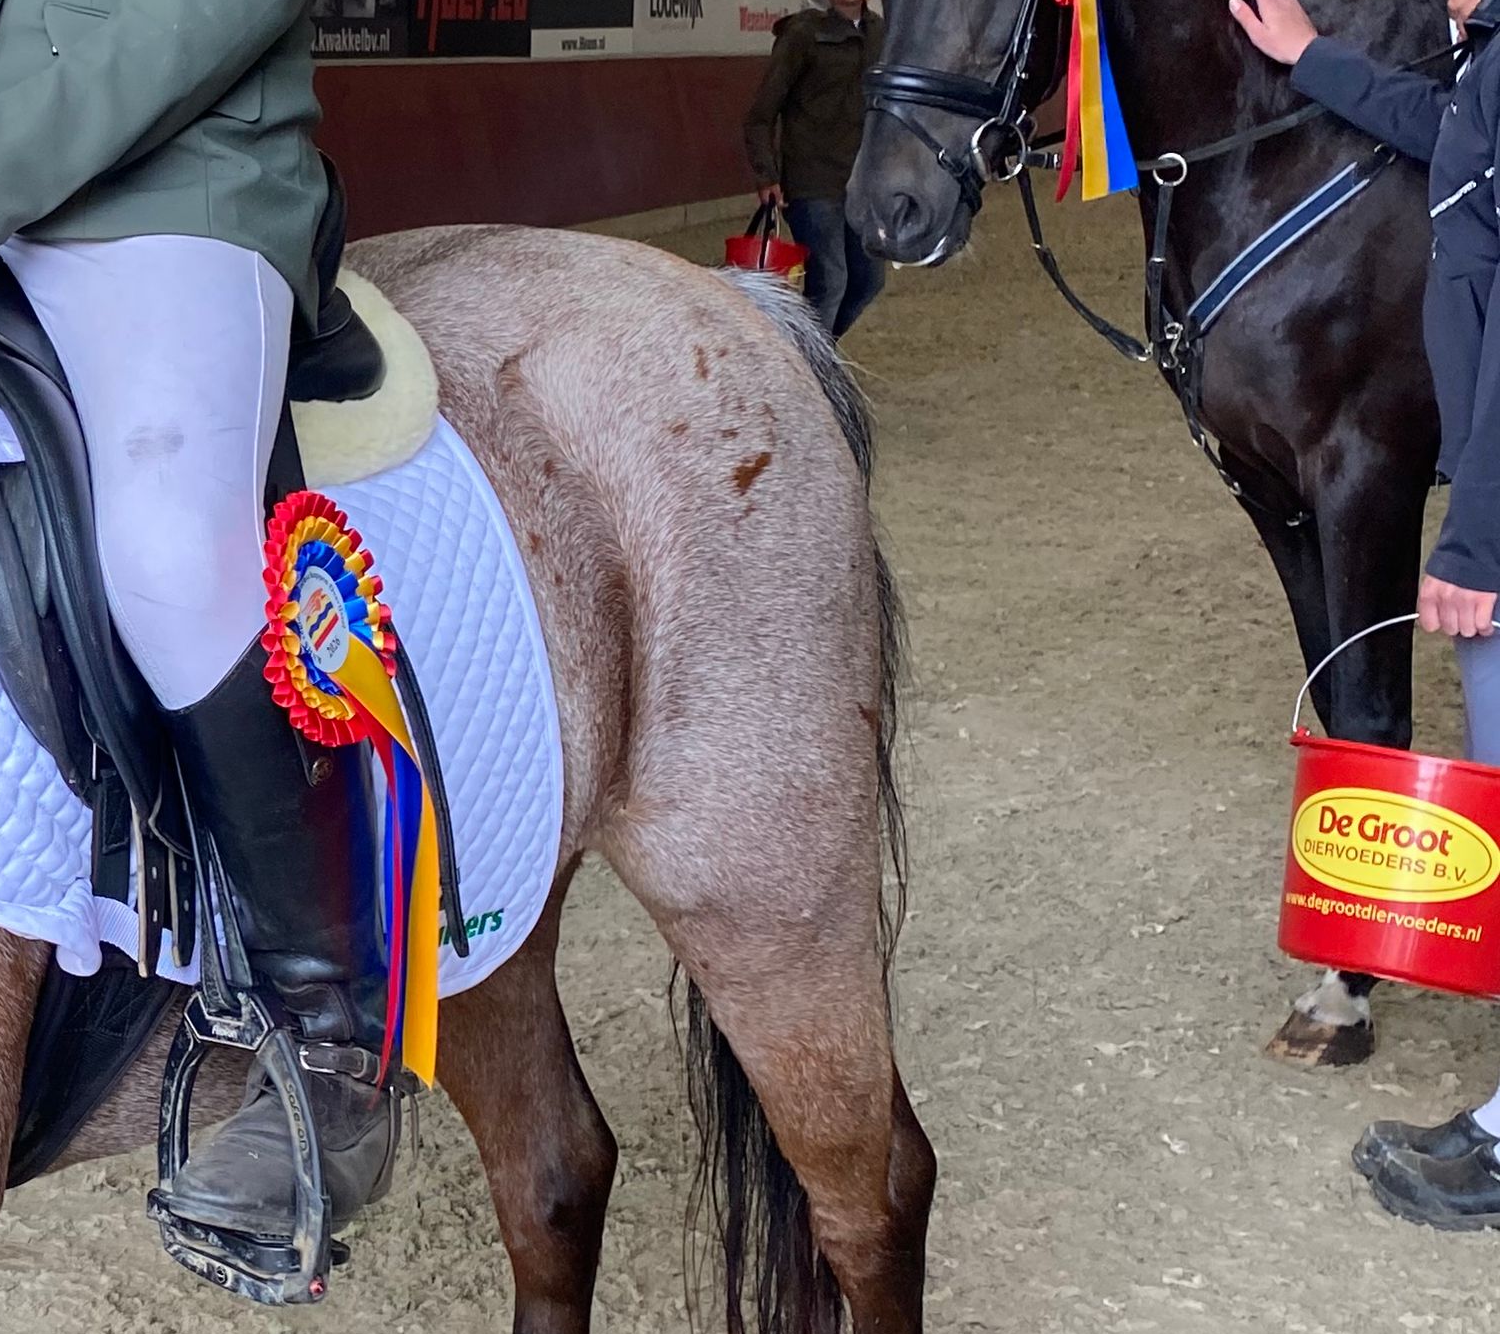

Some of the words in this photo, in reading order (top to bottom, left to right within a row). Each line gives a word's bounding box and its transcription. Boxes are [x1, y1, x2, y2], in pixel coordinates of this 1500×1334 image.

[311, 28, 390, 52] .kwakkelbv.nl
[1319, 805, 1353, 837] De
[1358, 813, 1453, 857] Groot
[1304, 838, 1427, 875] DIERVOEDERS
[1285, 892, 1482, 943] www.degrootdiervoeders.nl
